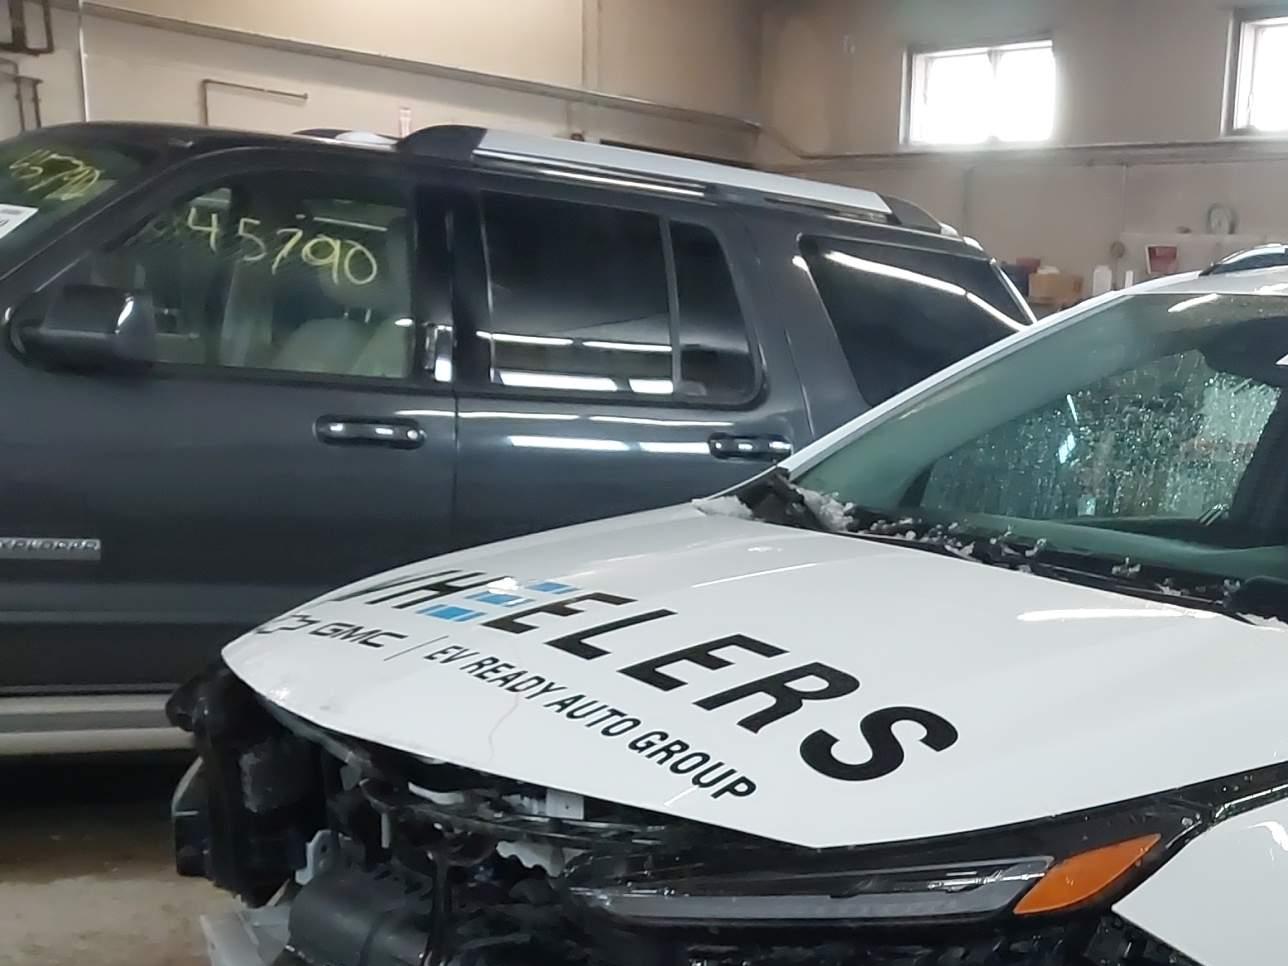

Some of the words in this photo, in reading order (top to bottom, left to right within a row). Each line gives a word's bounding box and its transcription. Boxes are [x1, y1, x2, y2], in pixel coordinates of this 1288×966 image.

[186, 207, 378, 285] 45790
[309, 622, 409, 649] GMC
[424, 645, 481, 664] EV
[459, 656, 567, 700] READY
[543, 694, 642, 737] AUTO
[627, 730, 757, 799] GROUP
[322, 569, 959, 782] WHEELERS
